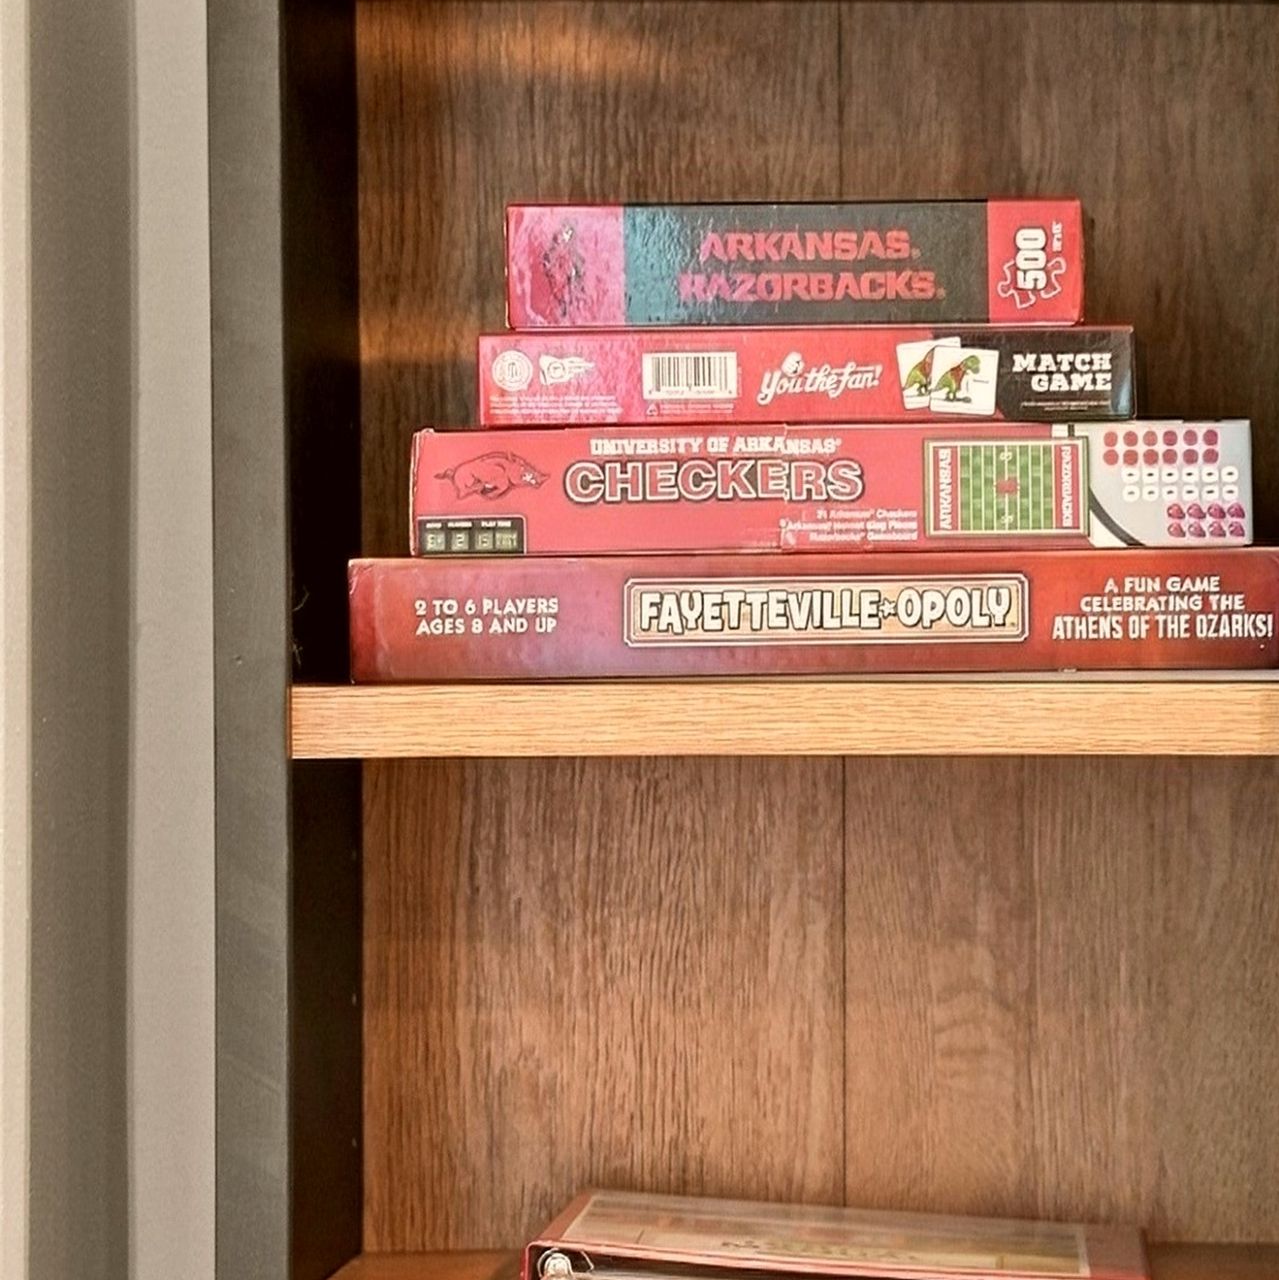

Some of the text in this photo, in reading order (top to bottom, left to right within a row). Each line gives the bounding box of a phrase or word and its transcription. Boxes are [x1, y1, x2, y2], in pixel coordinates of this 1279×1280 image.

[700, 230, 911, 260] ARKANSAS
[1015, 228, 1046, 290] 500
[679, 271, 936, 301] RAZORBACKS
[1012, 353, 1112, 372] MATCH
[1031, 373, 1112, 391] GAME
[590, 436, 836, 455] UNIVERSITY OF ARKANSAS
[564, 459, 864, 503] CHECKERS
[938, 448, 952, 531] ARKANSAS
[1061, 446, 1073, 528] RAZORBACKS
[1104, 575, 1221, 594] A FUN GAME
[414, 597, 559, 616] 2 TO 6 PLAYERS
[1080, 593, 1246, 613] CELEBRATING THE
[416, 617, 558, 636] AGES 8 AND UP
[1052, 614, 1274, 640] ATHENS OF THE OZARKS!
